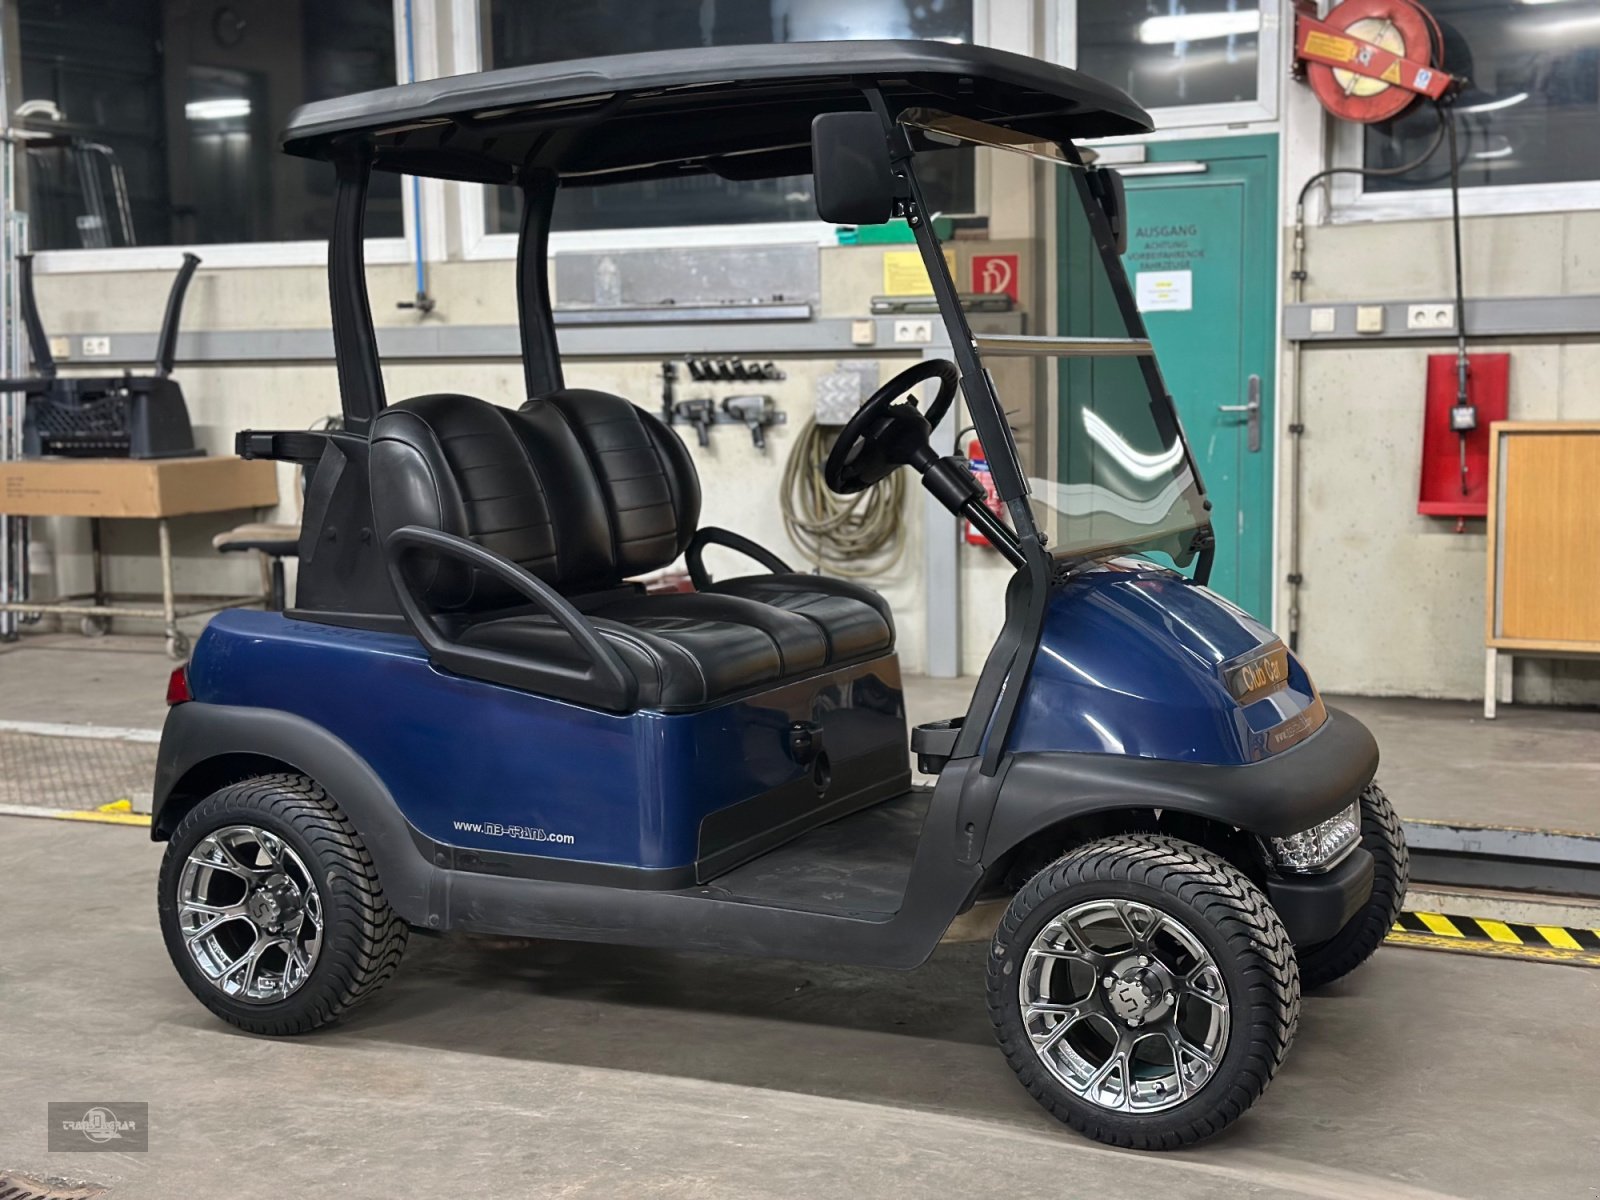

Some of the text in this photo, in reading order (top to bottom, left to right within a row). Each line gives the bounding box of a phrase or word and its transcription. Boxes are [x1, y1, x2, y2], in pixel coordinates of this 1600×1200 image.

[1135, 224, 1197, 237] AUSGANG
[1144, 240, 1189, 249] ACHTUNG
[1139, 260, 1191, 269] FAHRZEUGE
[1242, 657, 1281, 691] Club Car
